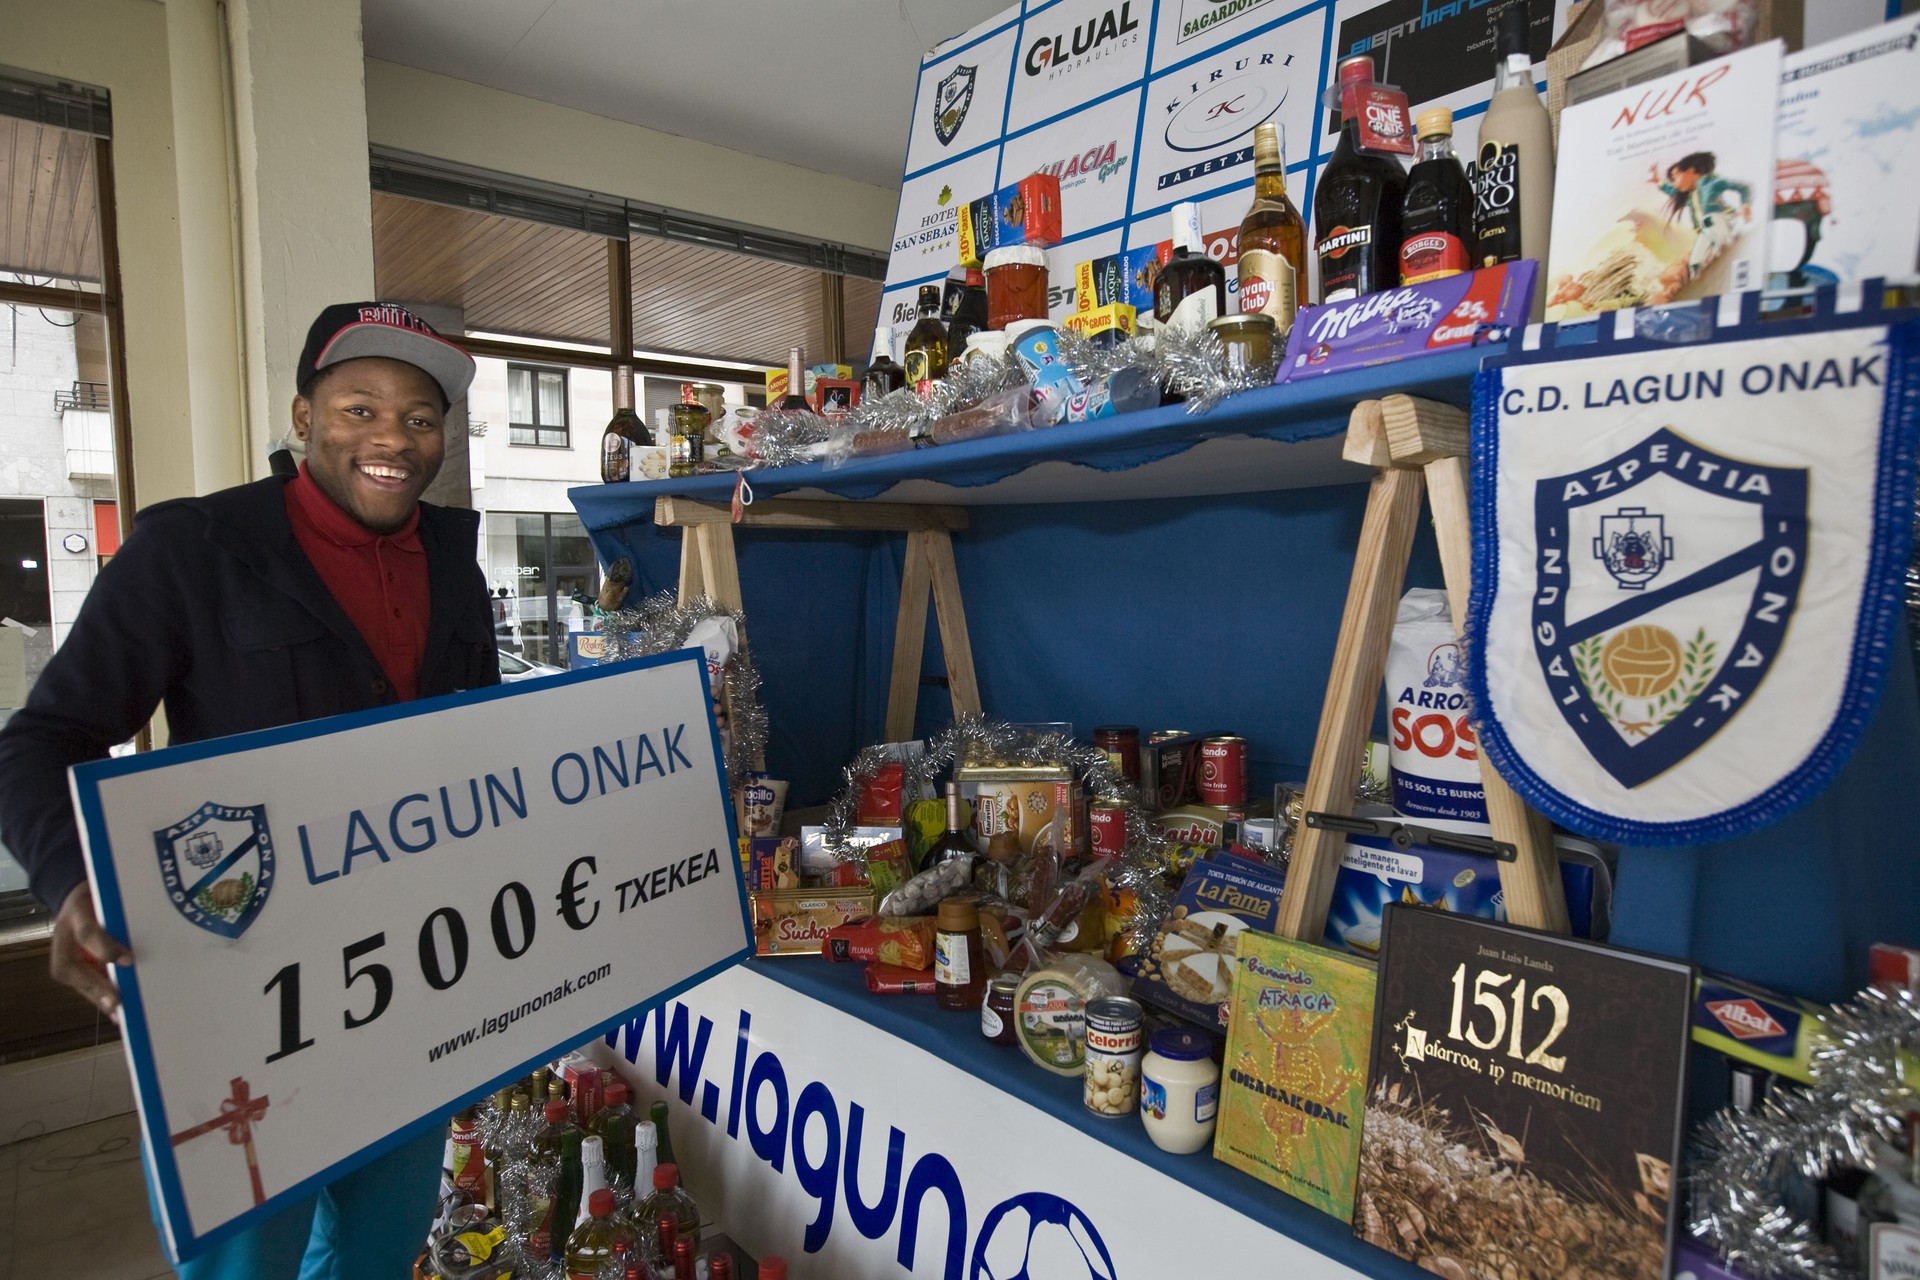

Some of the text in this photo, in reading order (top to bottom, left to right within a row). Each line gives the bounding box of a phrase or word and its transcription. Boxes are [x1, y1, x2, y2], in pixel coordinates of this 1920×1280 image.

[1025, 1, 1139, 77] GLUAL
[1049, 33, 1138, 81] HYDRAULICS
[1165, 53, 1295, 115] KIRURI
[1611, 64, 1729, 130] NUR
[1366, 106, 1402, 124] CINE
[894, 236, 917, 253] SAN
[1406, 239, 1440, 255] BORGES
[1240, 279, 1276, 299] avana
[1241, 293, 1265, 312] Club
[1308, 287, 1421, 344] Milka
[1502, 353, 1885, 416] C.D. LAGUN ONAK
[1562, 443, 1772, 503] AZPEITIA
[707, 663, 721, 676] OS
[1392, 707, 1479, 761] SOS
[297, 723, 693, 886] LAGUN ONAK
[1437, 787, 1448, 796] ES
[167, 805, 255, 839] AZPEITIA
[1459, 810, 1481, 819] 1903
[1344, 854, 1418, 878] inteligente de lavar
[1359, 850, 1400, 866] La manera
[614, 848, 720, 914] TXEKEA
[1207, 869, 1224, 880] TORTA
[1225, 873, 1247, 886] TURRÓN
[1247, 880, 1255, 888] DE
[1196, 878, 1271, 918] La Fama
[1477, 944, 1555, 973] Juan Luis Landa
[428, 963, 612, 1063] www.lagunonak.com
[1258, 988, 1333, 1011] ATXAGA
[1447, 962, 1570, 1074] 1512
[1714, 1001, 1771, 1033] Albal
[1489, 1060, 1505, 1085] in
[1512, 1070, 1601, 1112] memoriam
